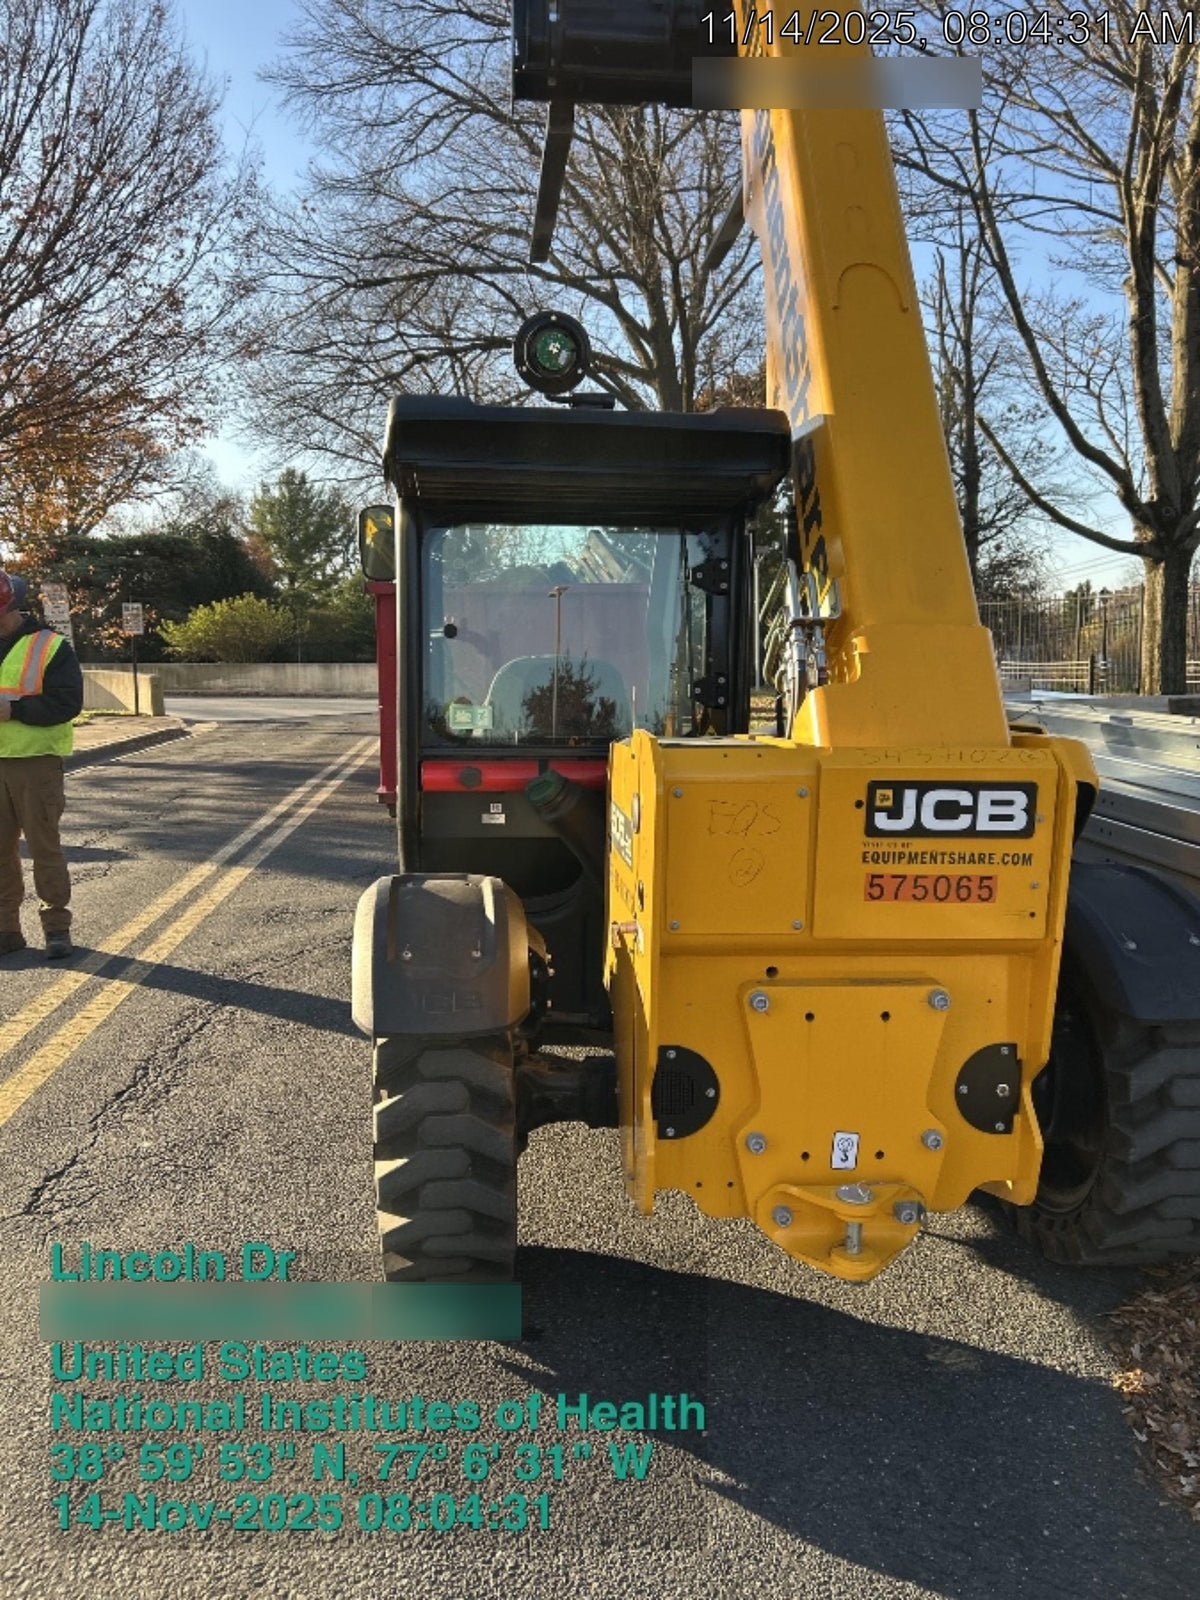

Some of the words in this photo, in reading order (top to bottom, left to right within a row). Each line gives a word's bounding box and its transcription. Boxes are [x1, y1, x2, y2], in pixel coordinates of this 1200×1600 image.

[873, 788, 1029, 831] JCB
[862, 850, 1034, 867] EQUIPMENTSHARE.COM
[867, 874, 994, 902] 575065
